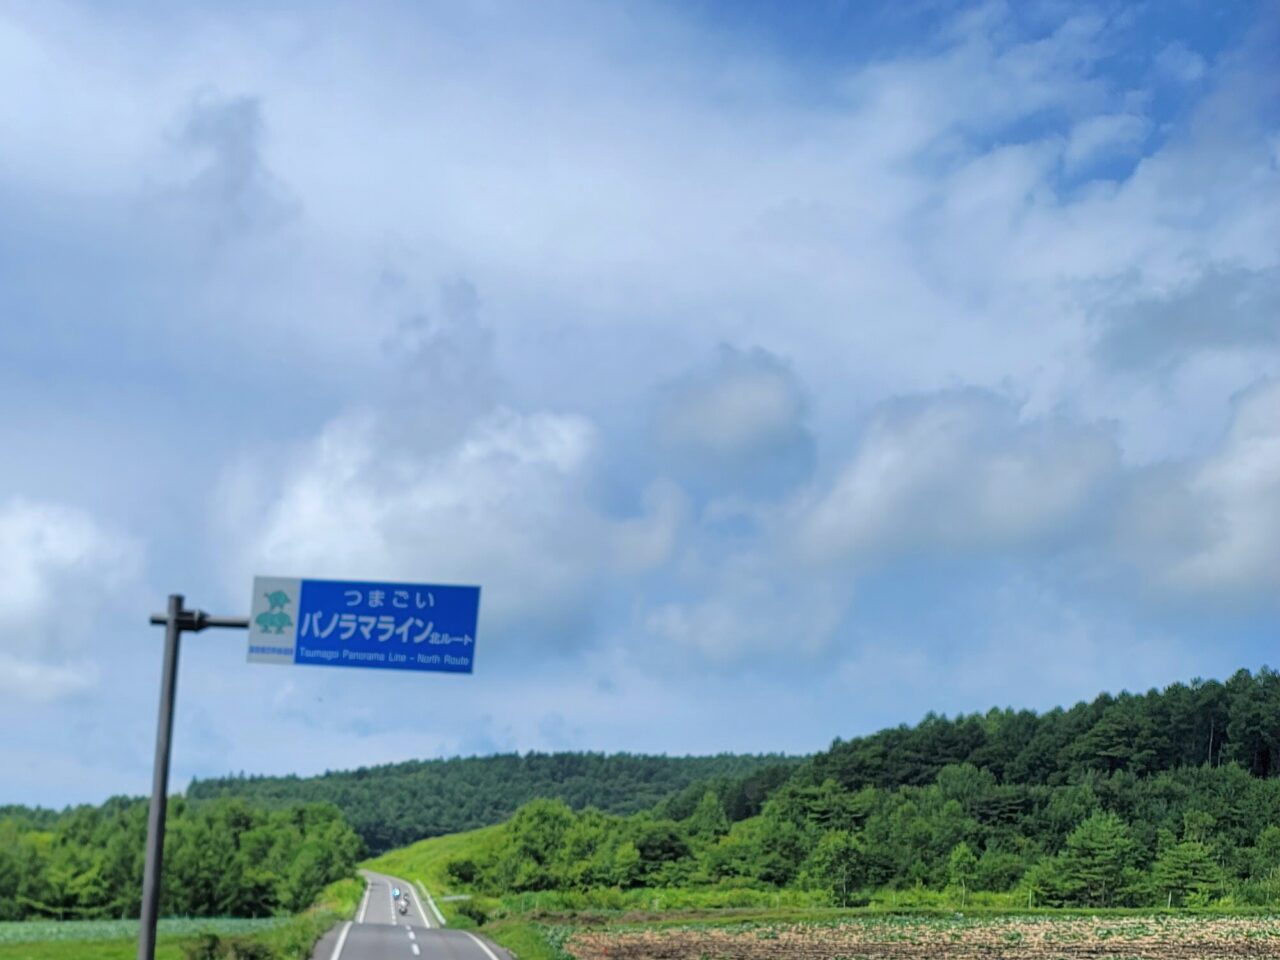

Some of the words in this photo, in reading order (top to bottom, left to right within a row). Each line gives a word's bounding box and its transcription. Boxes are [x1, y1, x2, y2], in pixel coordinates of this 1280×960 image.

[344, 589, 435, 609] つまごい
[343, 650, 385, 662] Panorama
[388, 653, 407, 662] Line
[417, 654, 441, 664] North
[444, 655, 470, 665] Route
